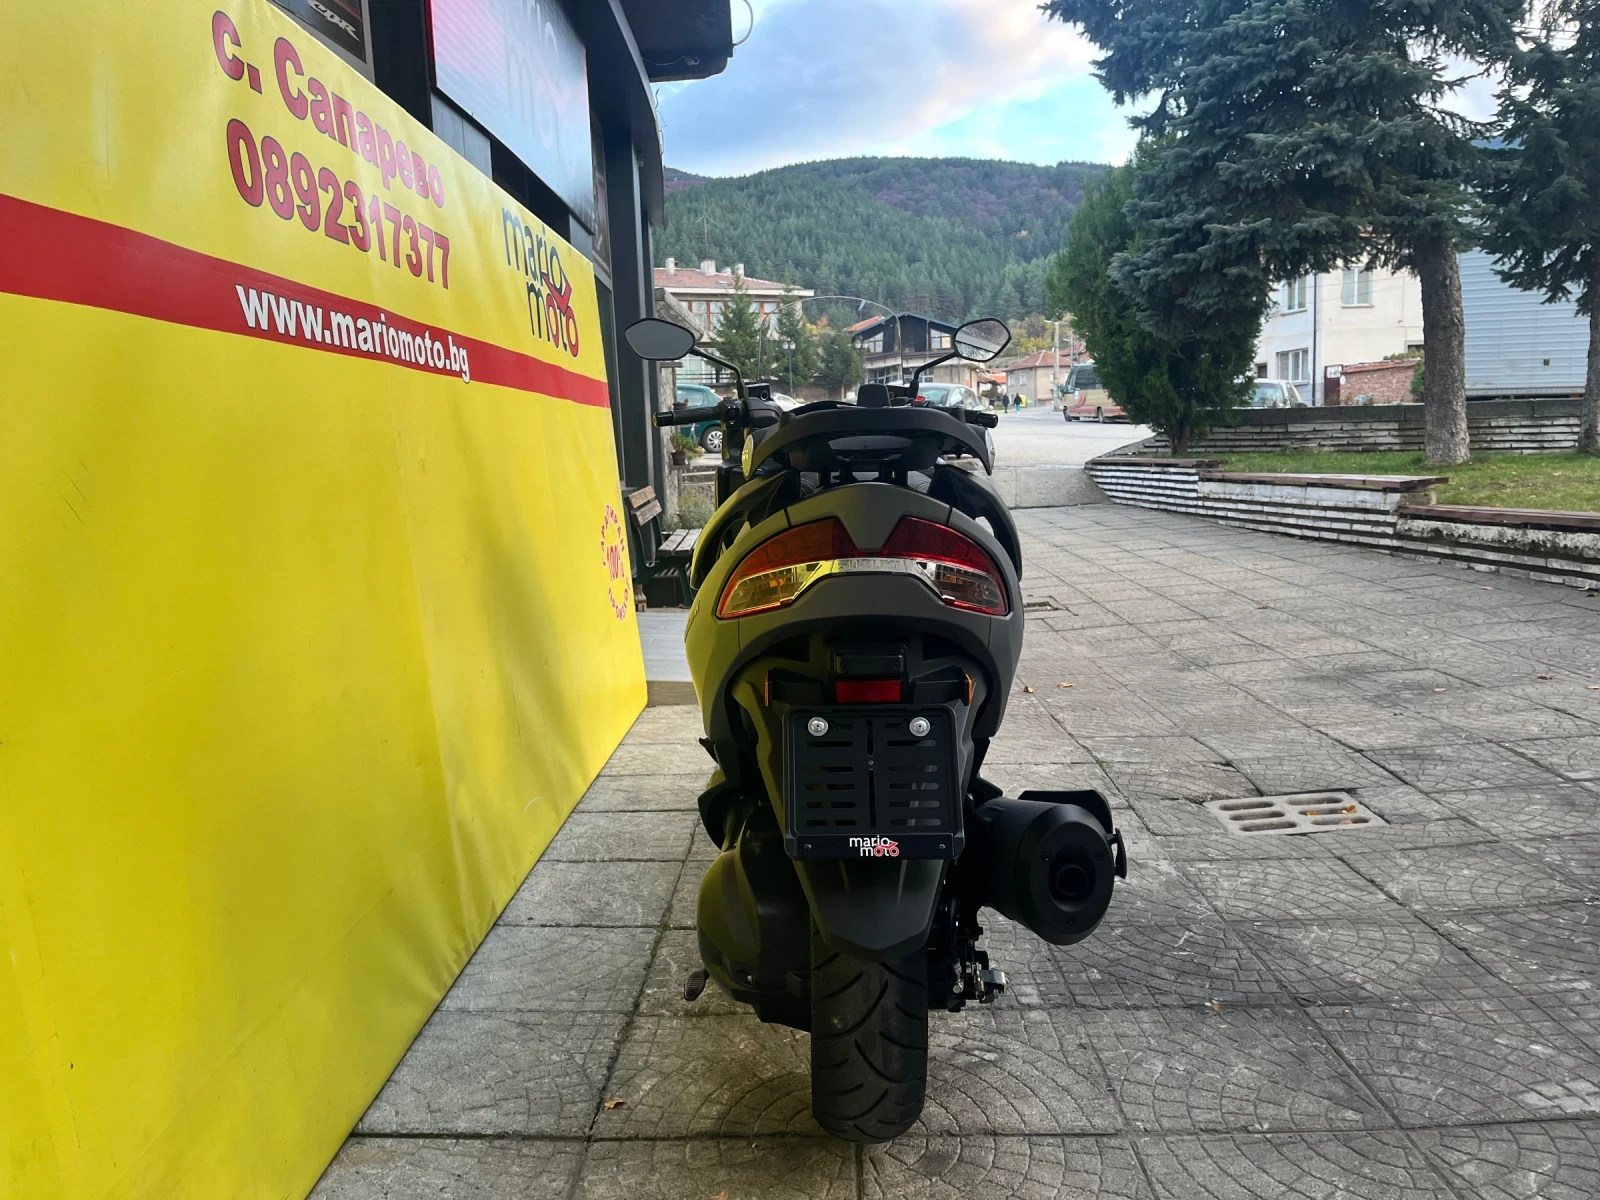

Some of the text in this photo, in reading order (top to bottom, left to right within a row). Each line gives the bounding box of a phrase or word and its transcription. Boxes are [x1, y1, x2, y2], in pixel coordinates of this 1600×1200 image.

[273, 36, 445, 208] Сапарево
[226, 118, 450, 290] 0892317377
[501, 207, 565, 294] mario
[234, 283, 471, 384] www.mariomoto.bg
[526, 279, 579, 358] moto
[839, 558, 901, 571] SUZUKI
[849, 834, 891, 847] mario
[860, 844, 900, 857] moto
